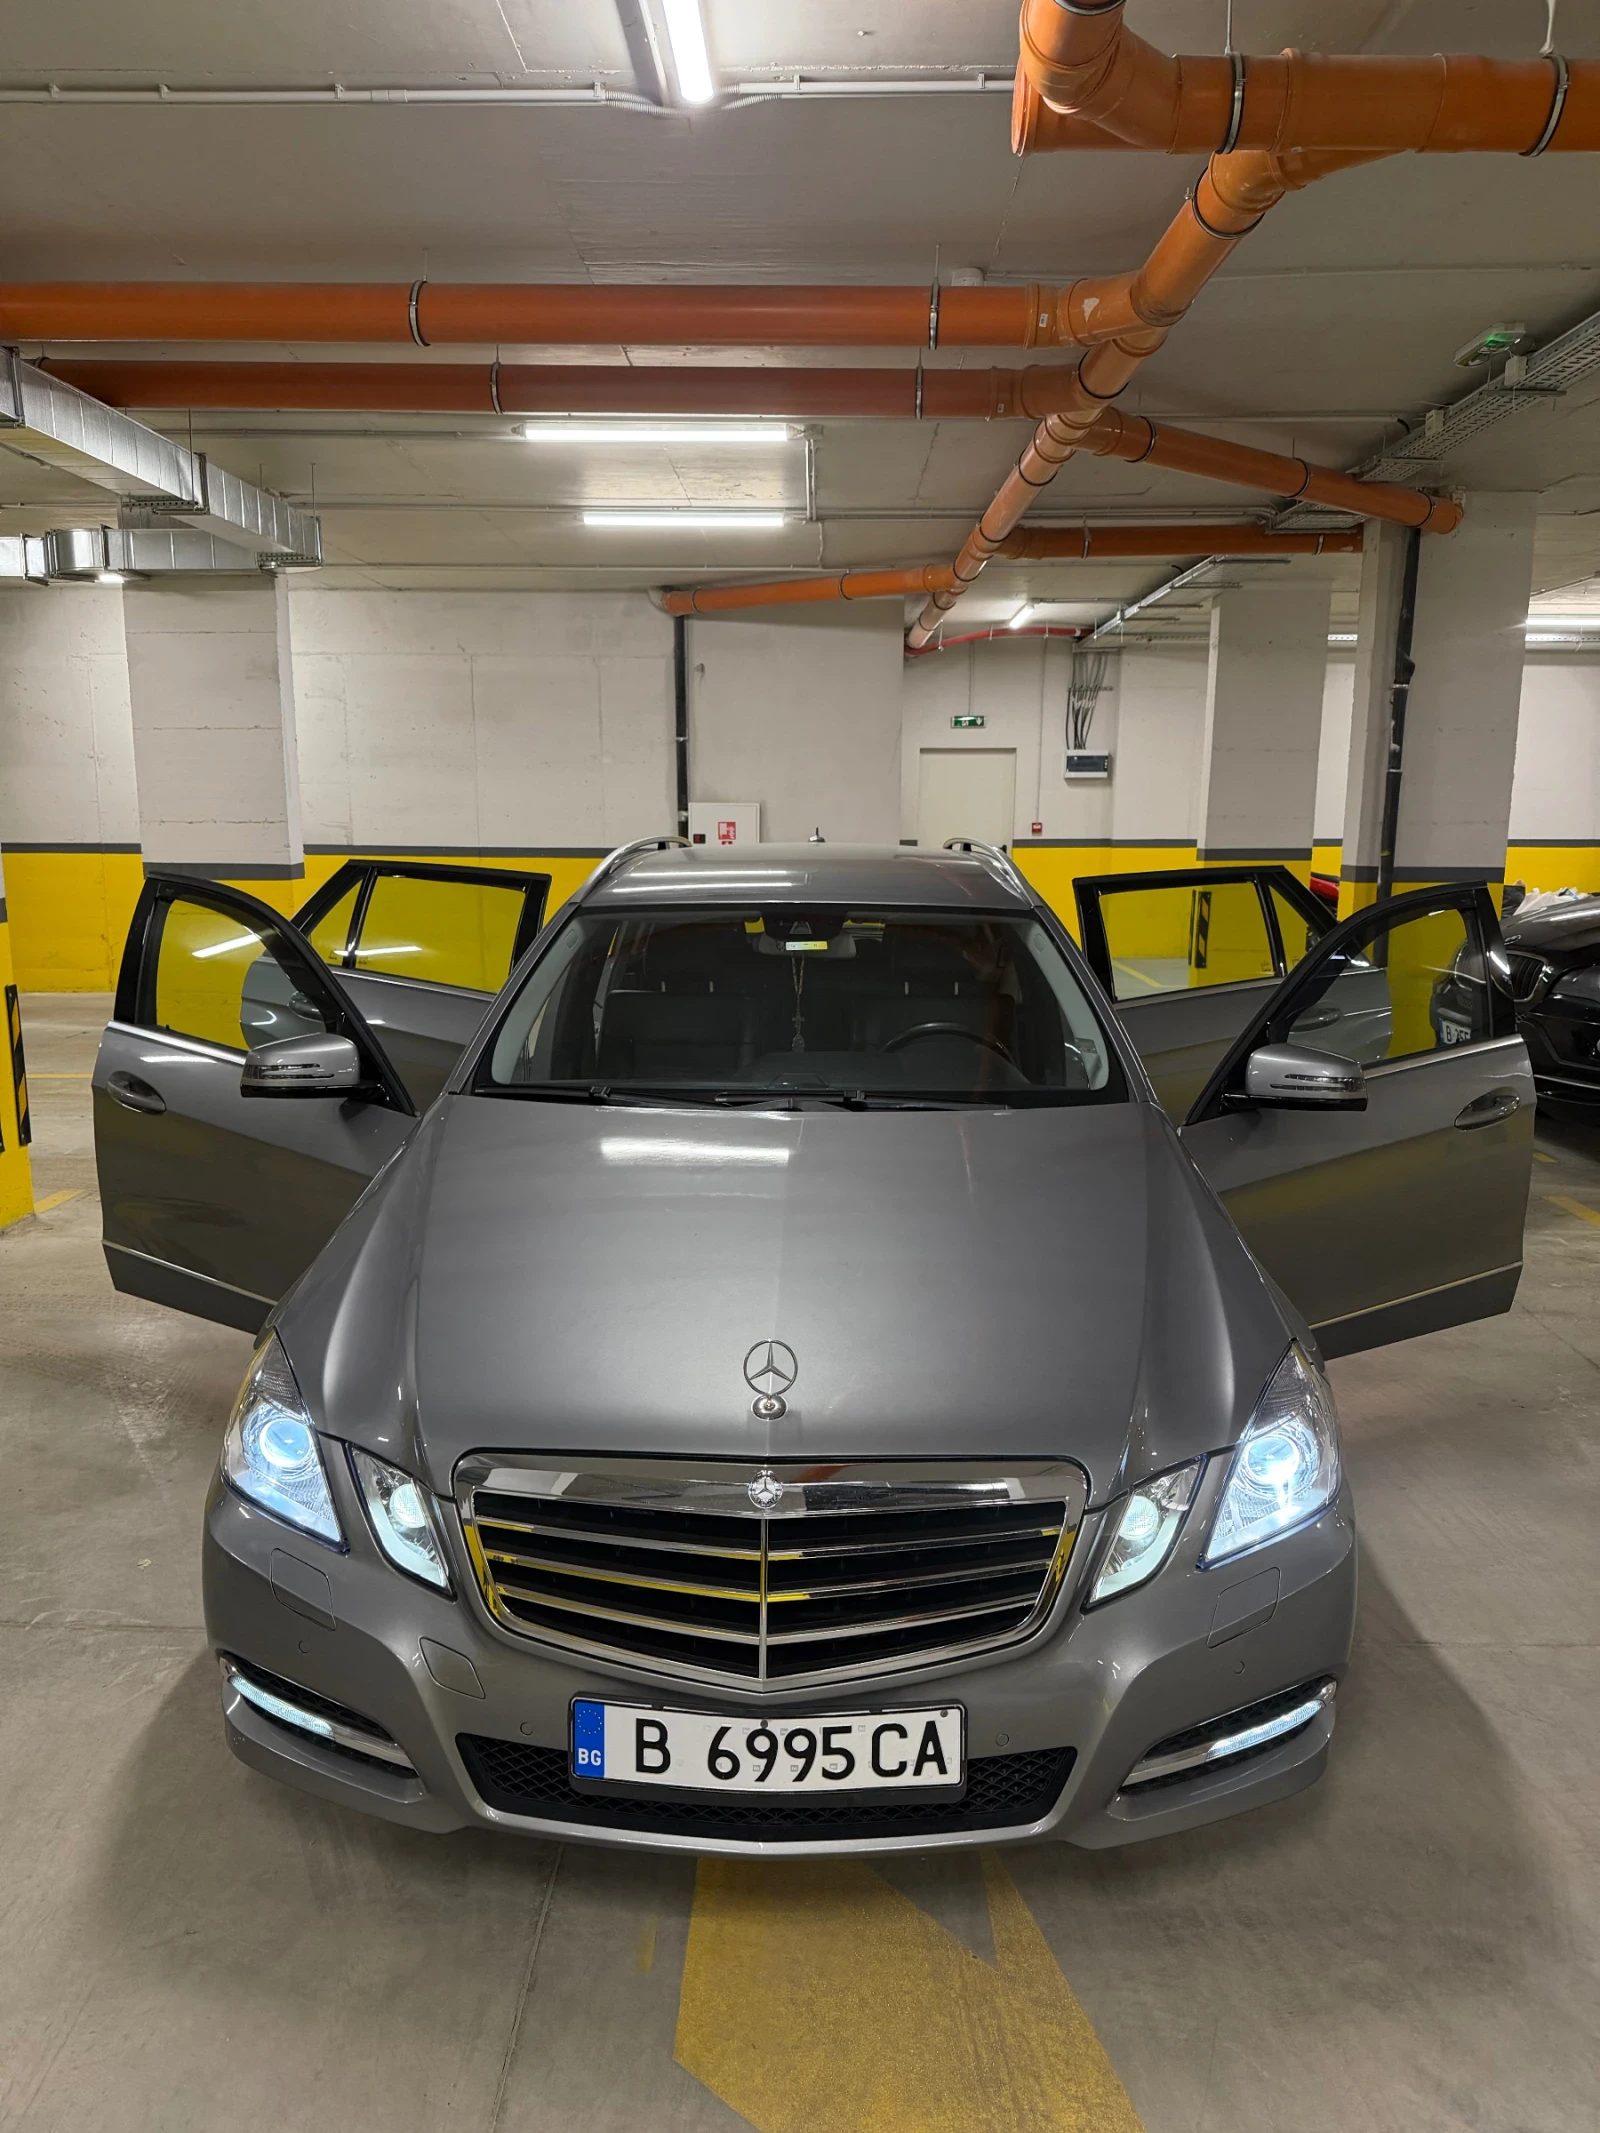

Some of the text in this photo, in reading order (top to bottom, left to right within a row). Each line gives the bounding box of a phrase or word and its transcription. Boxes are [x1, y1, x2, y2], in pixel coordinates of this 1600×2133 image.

[1446, 1024, 1453, 1042] B
[578, 1747, 602, 1766] BG
[635, 1718, 948, 1783] B 6995 CA
